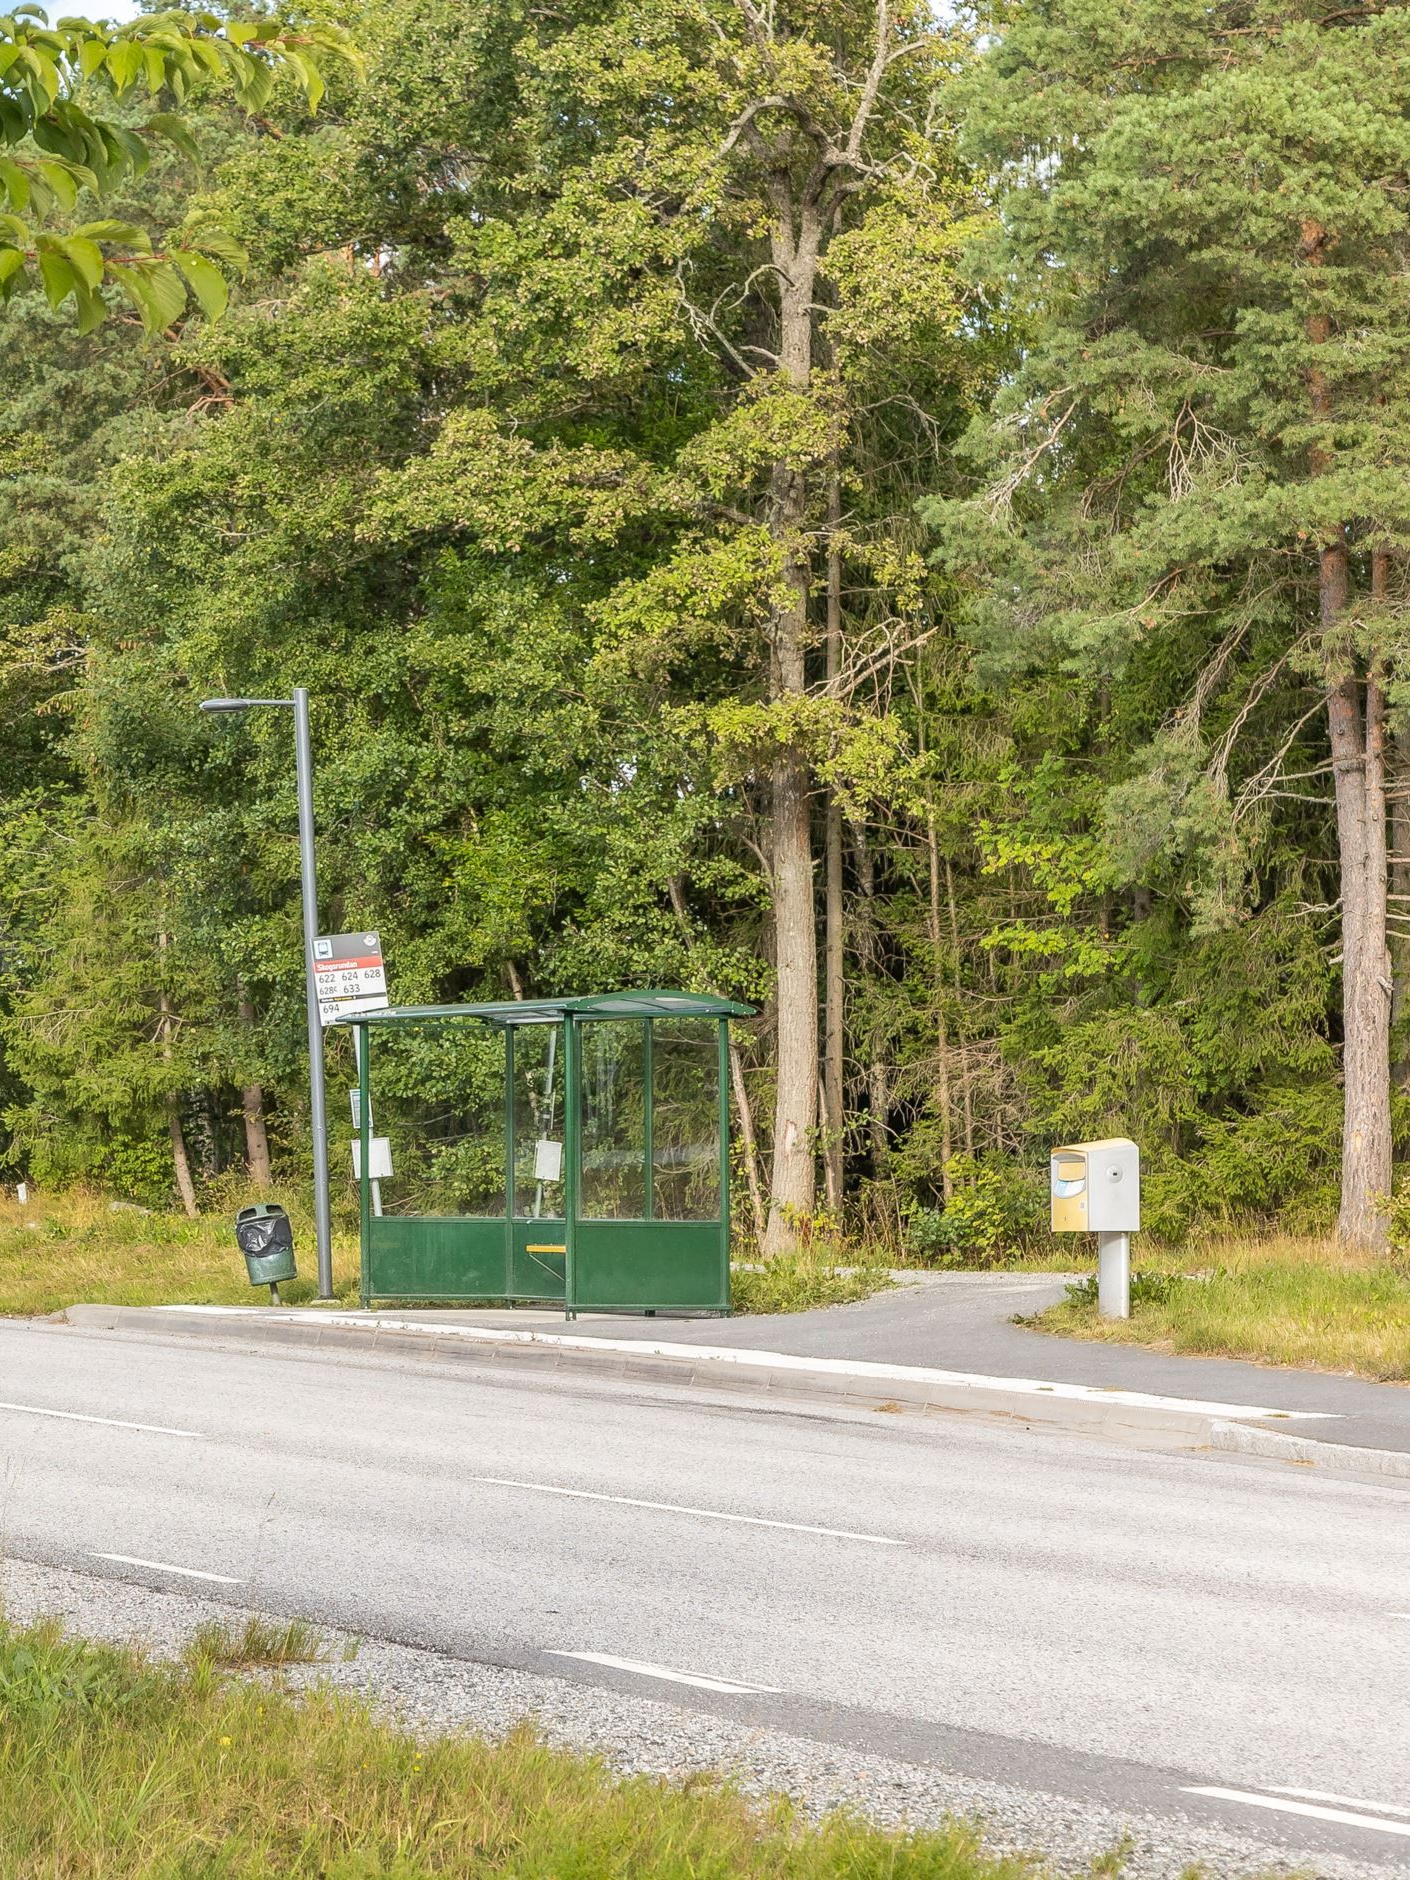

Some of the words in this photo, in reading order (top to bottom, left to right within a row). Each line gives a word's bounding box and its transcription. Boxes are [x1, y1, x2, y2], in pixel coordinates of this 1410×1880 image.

[319, 974, 336, 983] 622
[342, 971, 358, 981] 624
[364, 969, 381, 979] 628
[343, 984, 360, 994] 633
[323, 1004, 340, 1014] 694
